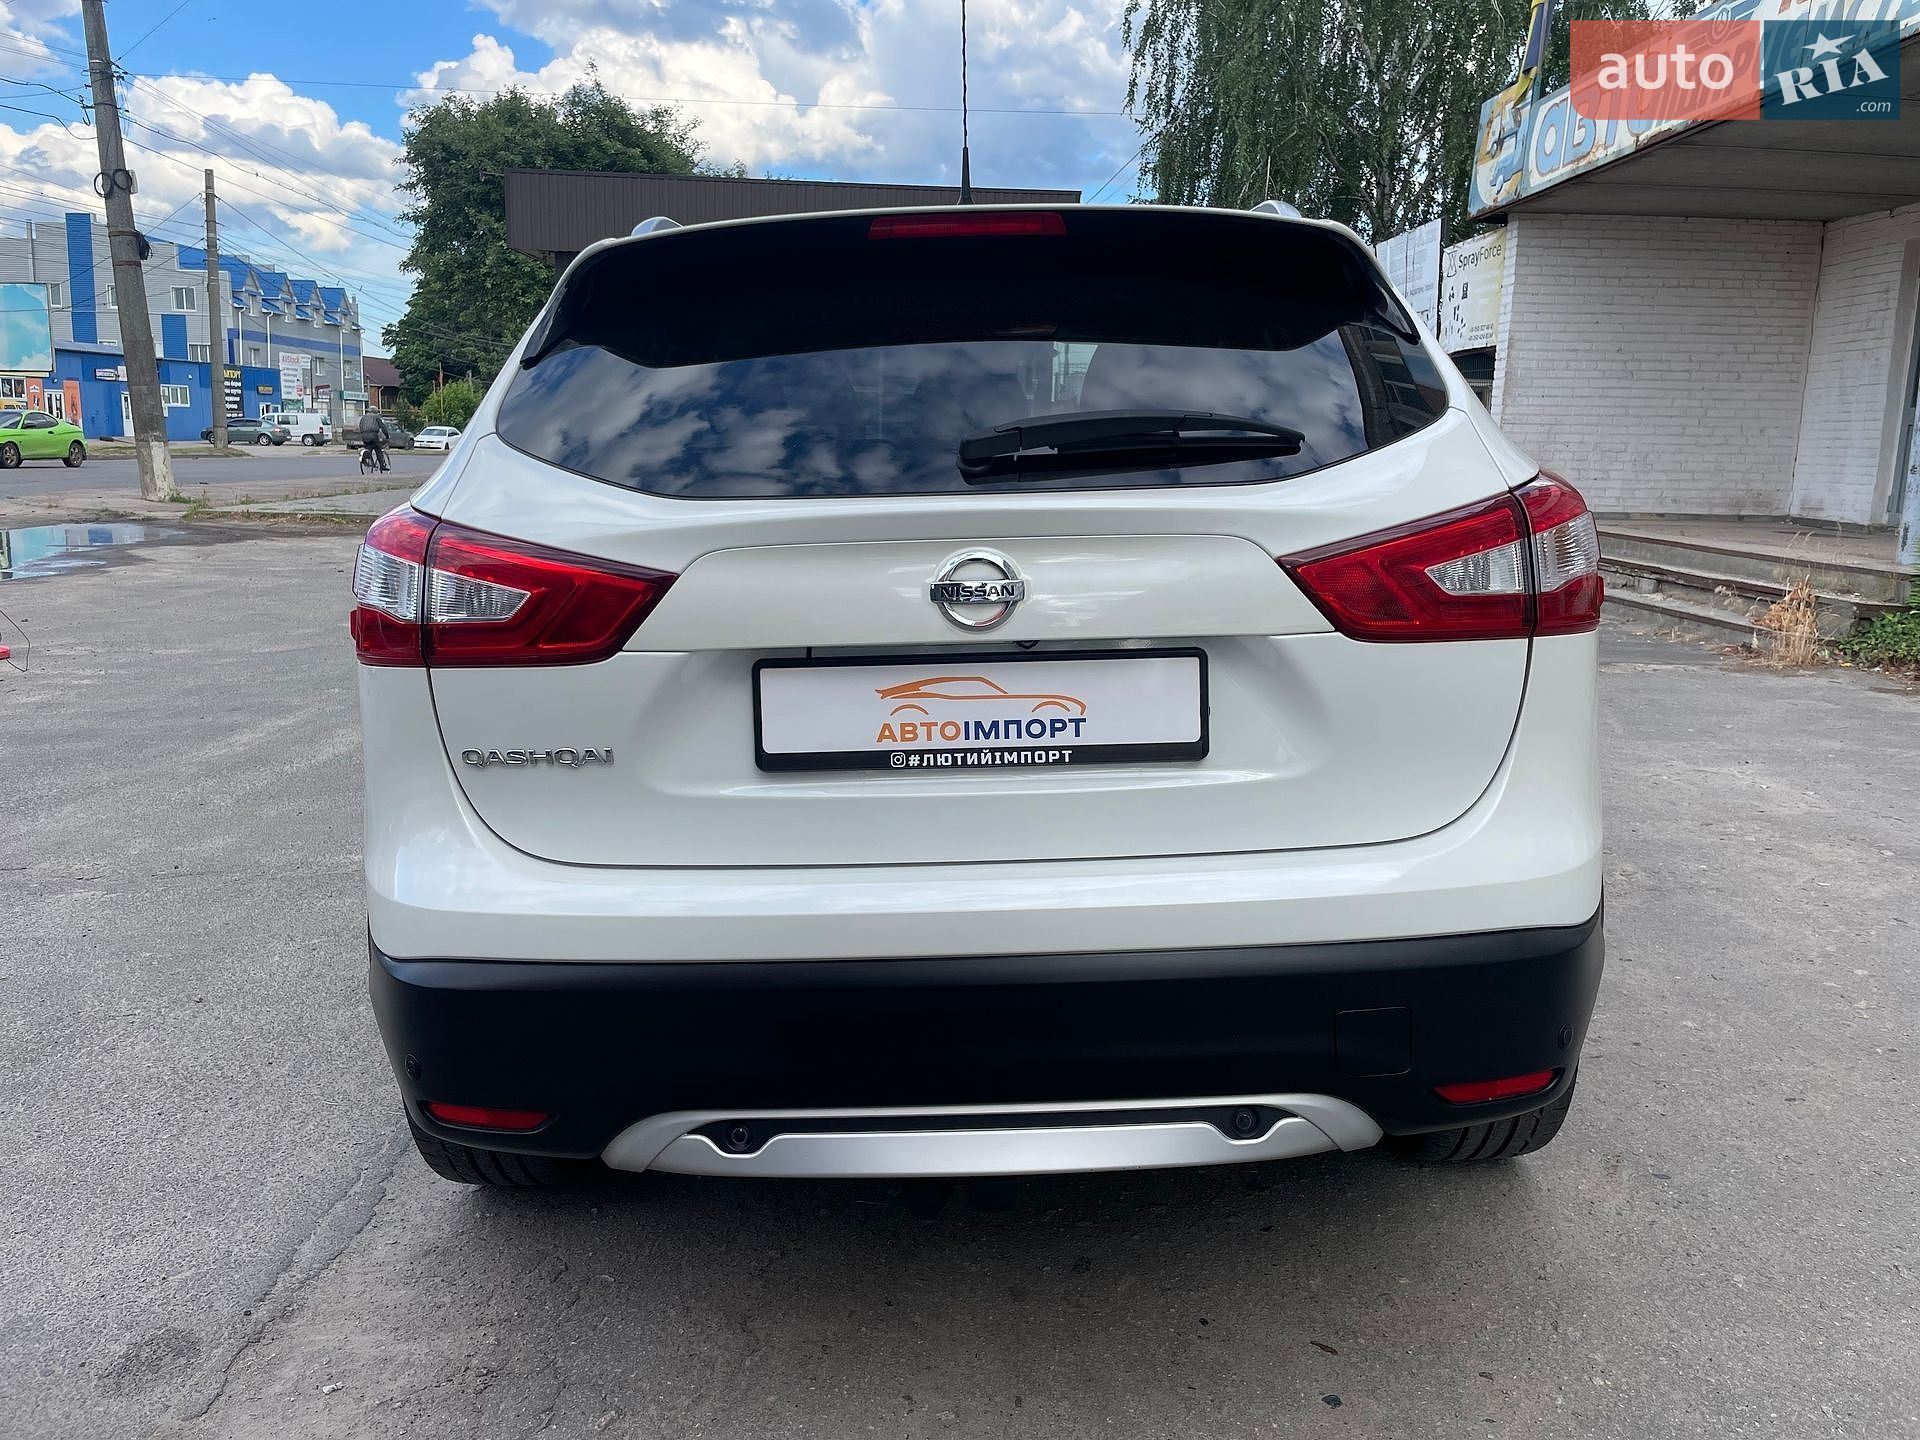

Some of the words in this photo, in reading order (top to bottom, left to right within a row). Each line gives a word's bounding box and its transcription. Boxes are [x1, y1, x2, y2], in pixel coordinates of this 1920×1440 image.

[1458, 243, 1502, 269] SprayForce
[939, 583, 1017, 600] NISSAN
[875, 716, 1088, 744] АВТОІМПОРТ
[461, 747, 615, 768] QASHQAI
